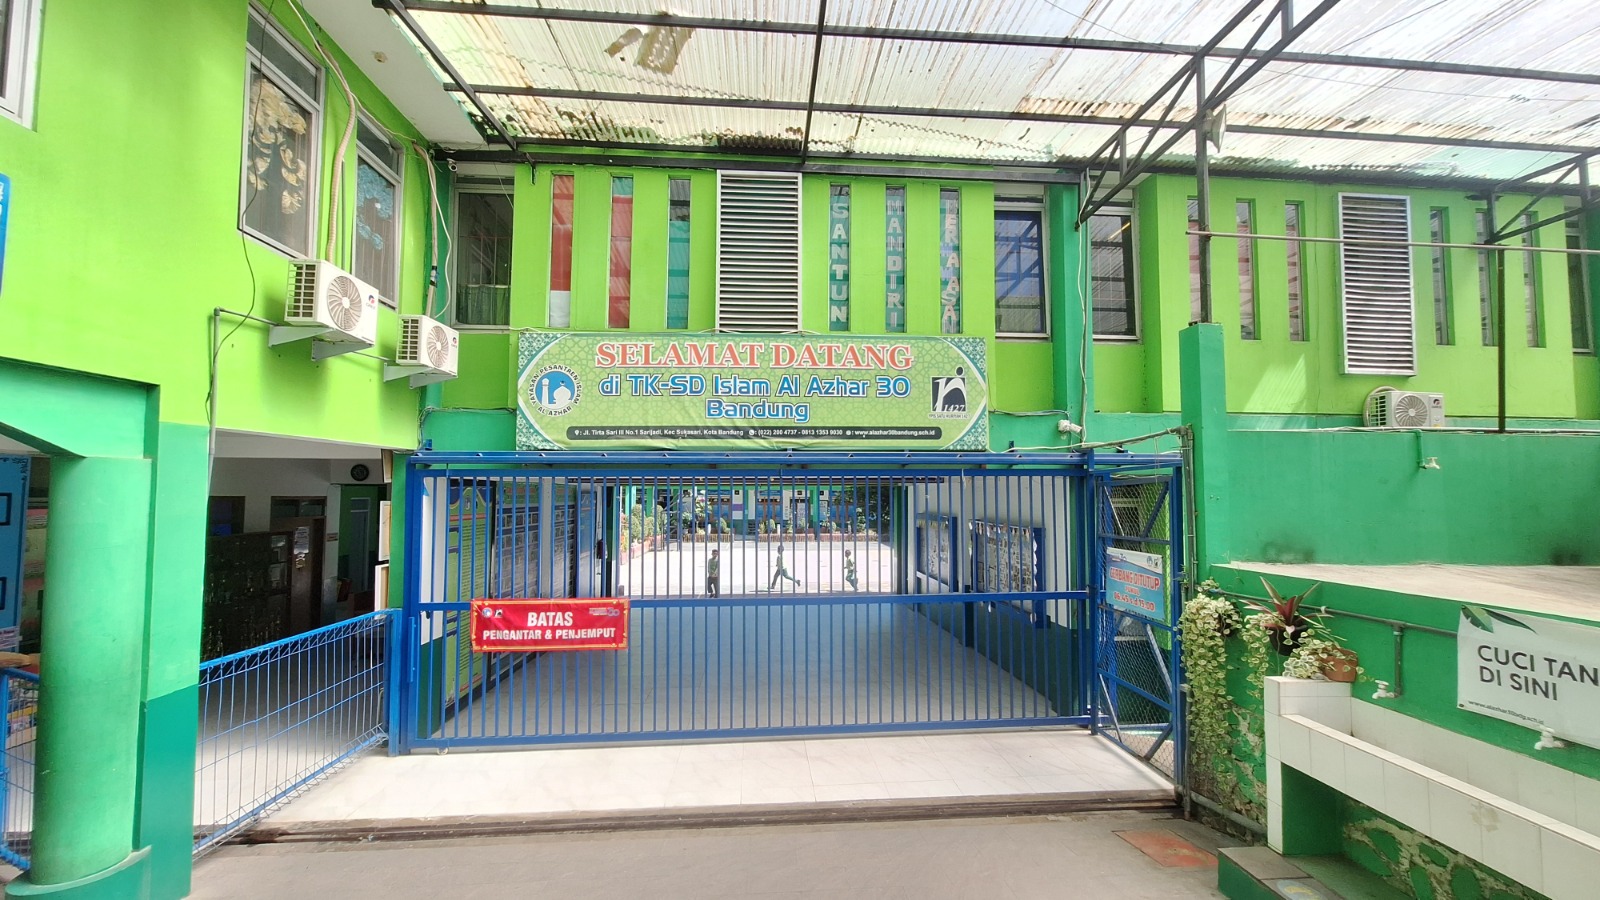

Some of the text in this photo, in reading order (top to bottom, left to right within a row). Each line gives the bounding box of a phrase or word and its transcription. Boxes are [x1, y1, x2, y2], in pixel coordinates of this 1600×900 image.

[830, 203, 848, 322] SANTUN
[887, 200, 903, 328] MANDIRI
[595, 342, 914, 370] SELAMAT DATANG
[529, 364, 582, 405] YAYASAN PESANTREN ISLAM
[598, 373, 912, 398] di TK-SD Islam Al Azhar 30
[538, 405, 572, 416] AL AZHAR
[705, 398, 810, 424] Bandung
[943, 404, 965, 412] 1427
[639, 429, 663, 437] Sarijadi,
[718, 429, 744, 437] Bandung
[757, 429, 772, 437] (022)
[527, 611, 574, 627] BATAS
[482, 627, 616, 641] PENGANTAR & PENJEMPUT
[1478, 645, 1599, 687] CUCI TAN
[1479, 665, 1558, 701] DI SINI
